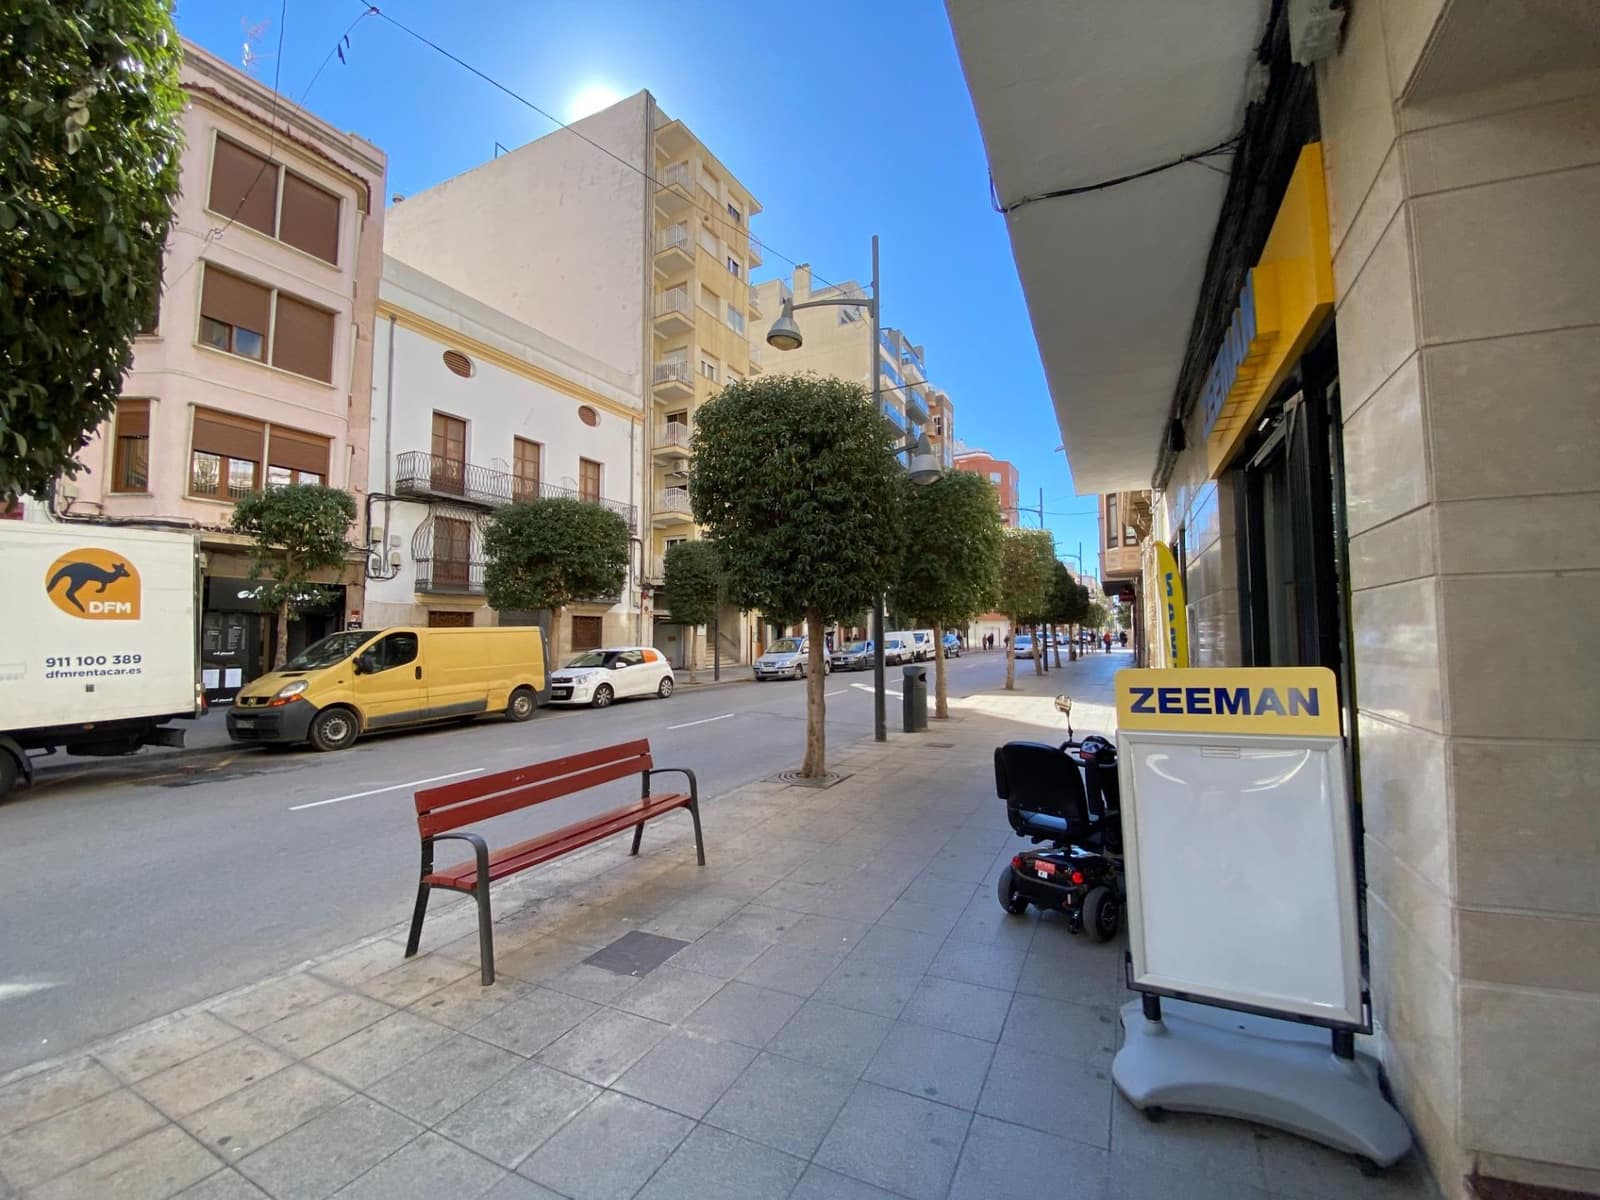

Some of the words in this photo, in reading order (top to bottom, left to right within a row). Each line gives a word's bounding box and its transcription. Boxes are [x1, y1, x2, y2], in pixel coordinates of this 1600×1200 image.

[89, 601, 132, 614] DFM
[46, 656, 70, 668] 911
[76, 655, 107, 666] 100
[112, 654, 142, 665] 389
[46, 667, 142, 679] dfmrentacar.es
[1129, 687, 1320, 717] ZEEMAN
